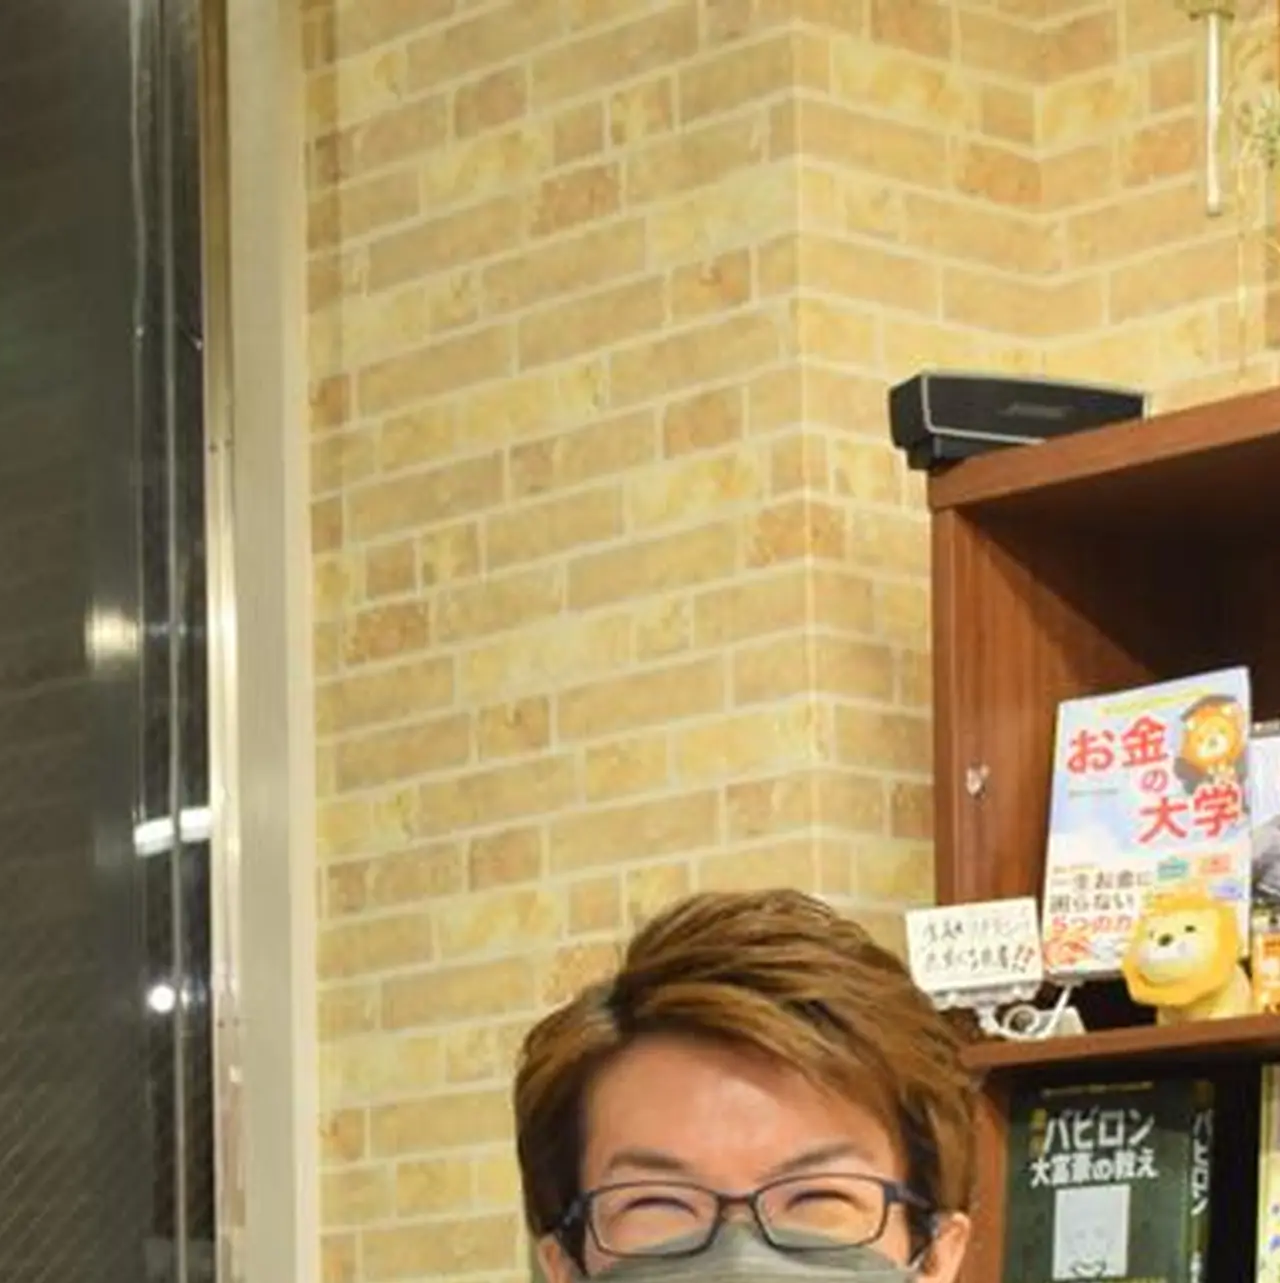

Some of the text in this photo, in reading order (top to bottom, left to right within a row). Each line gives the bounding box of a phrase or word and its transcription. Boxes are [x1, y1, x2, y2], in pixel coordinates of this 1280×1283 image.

[1138, 780, 1243, 845] 大学
[1043, 1104, 1155, 1154] バビロン
